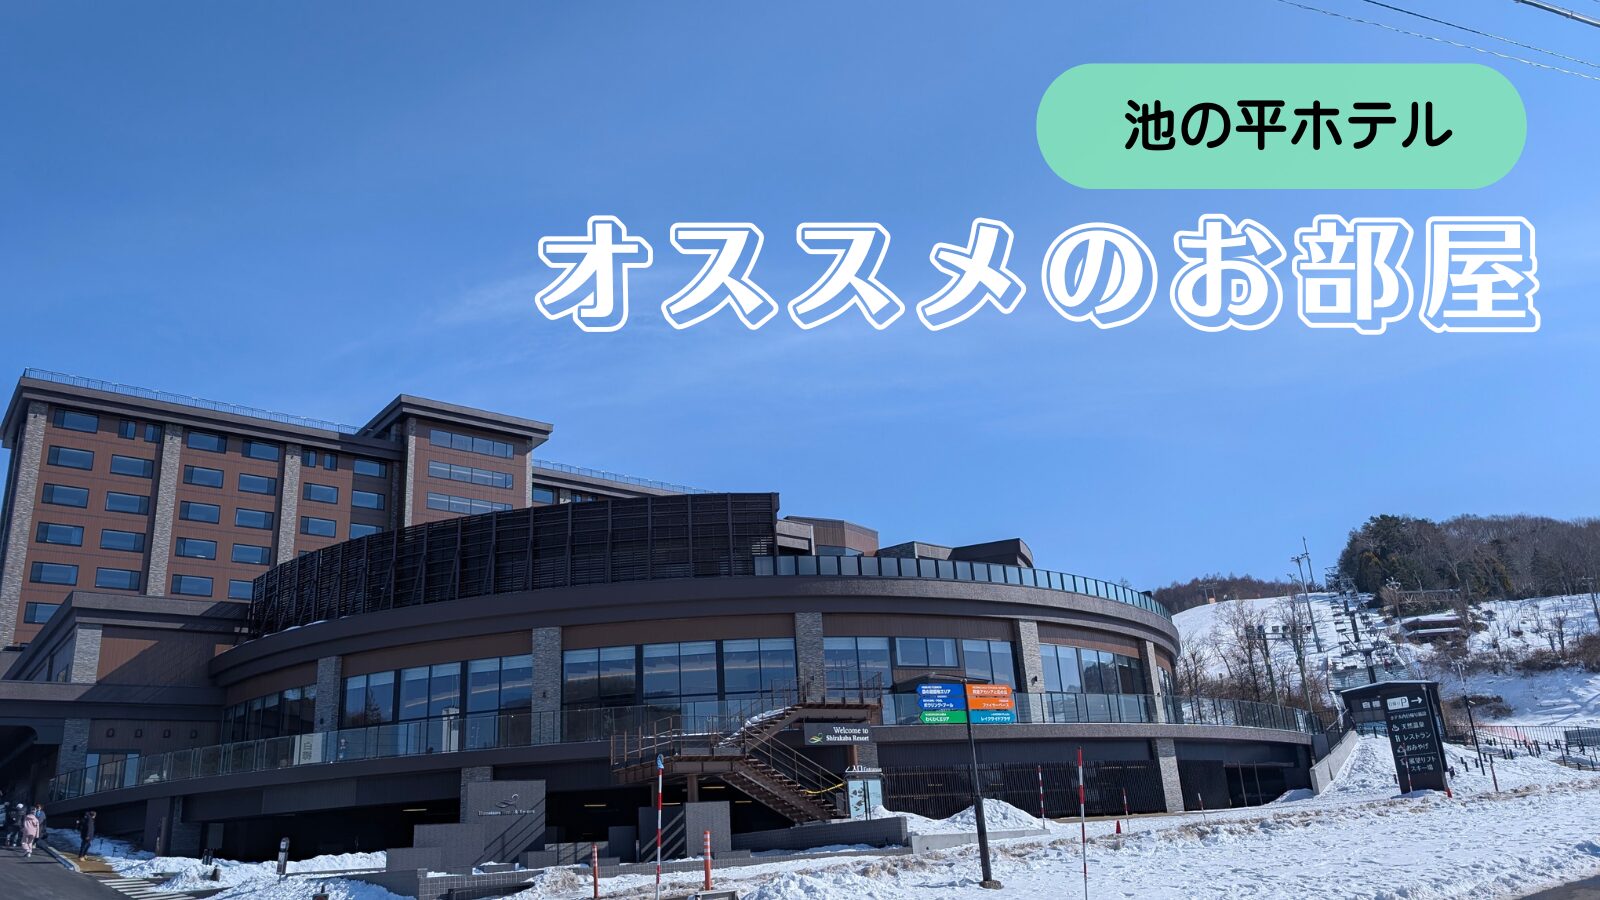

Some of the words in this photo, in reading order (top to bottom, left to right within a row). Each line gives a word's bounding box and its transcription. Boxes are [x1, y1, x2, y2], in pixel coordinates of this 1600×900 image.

[1401, 697, 1407, 707] P
[833, 726, 861, 734] Welcome
[1403, 731, 1431, 741] レストラン
[1406, 742, 1429, 752] おみやげ
